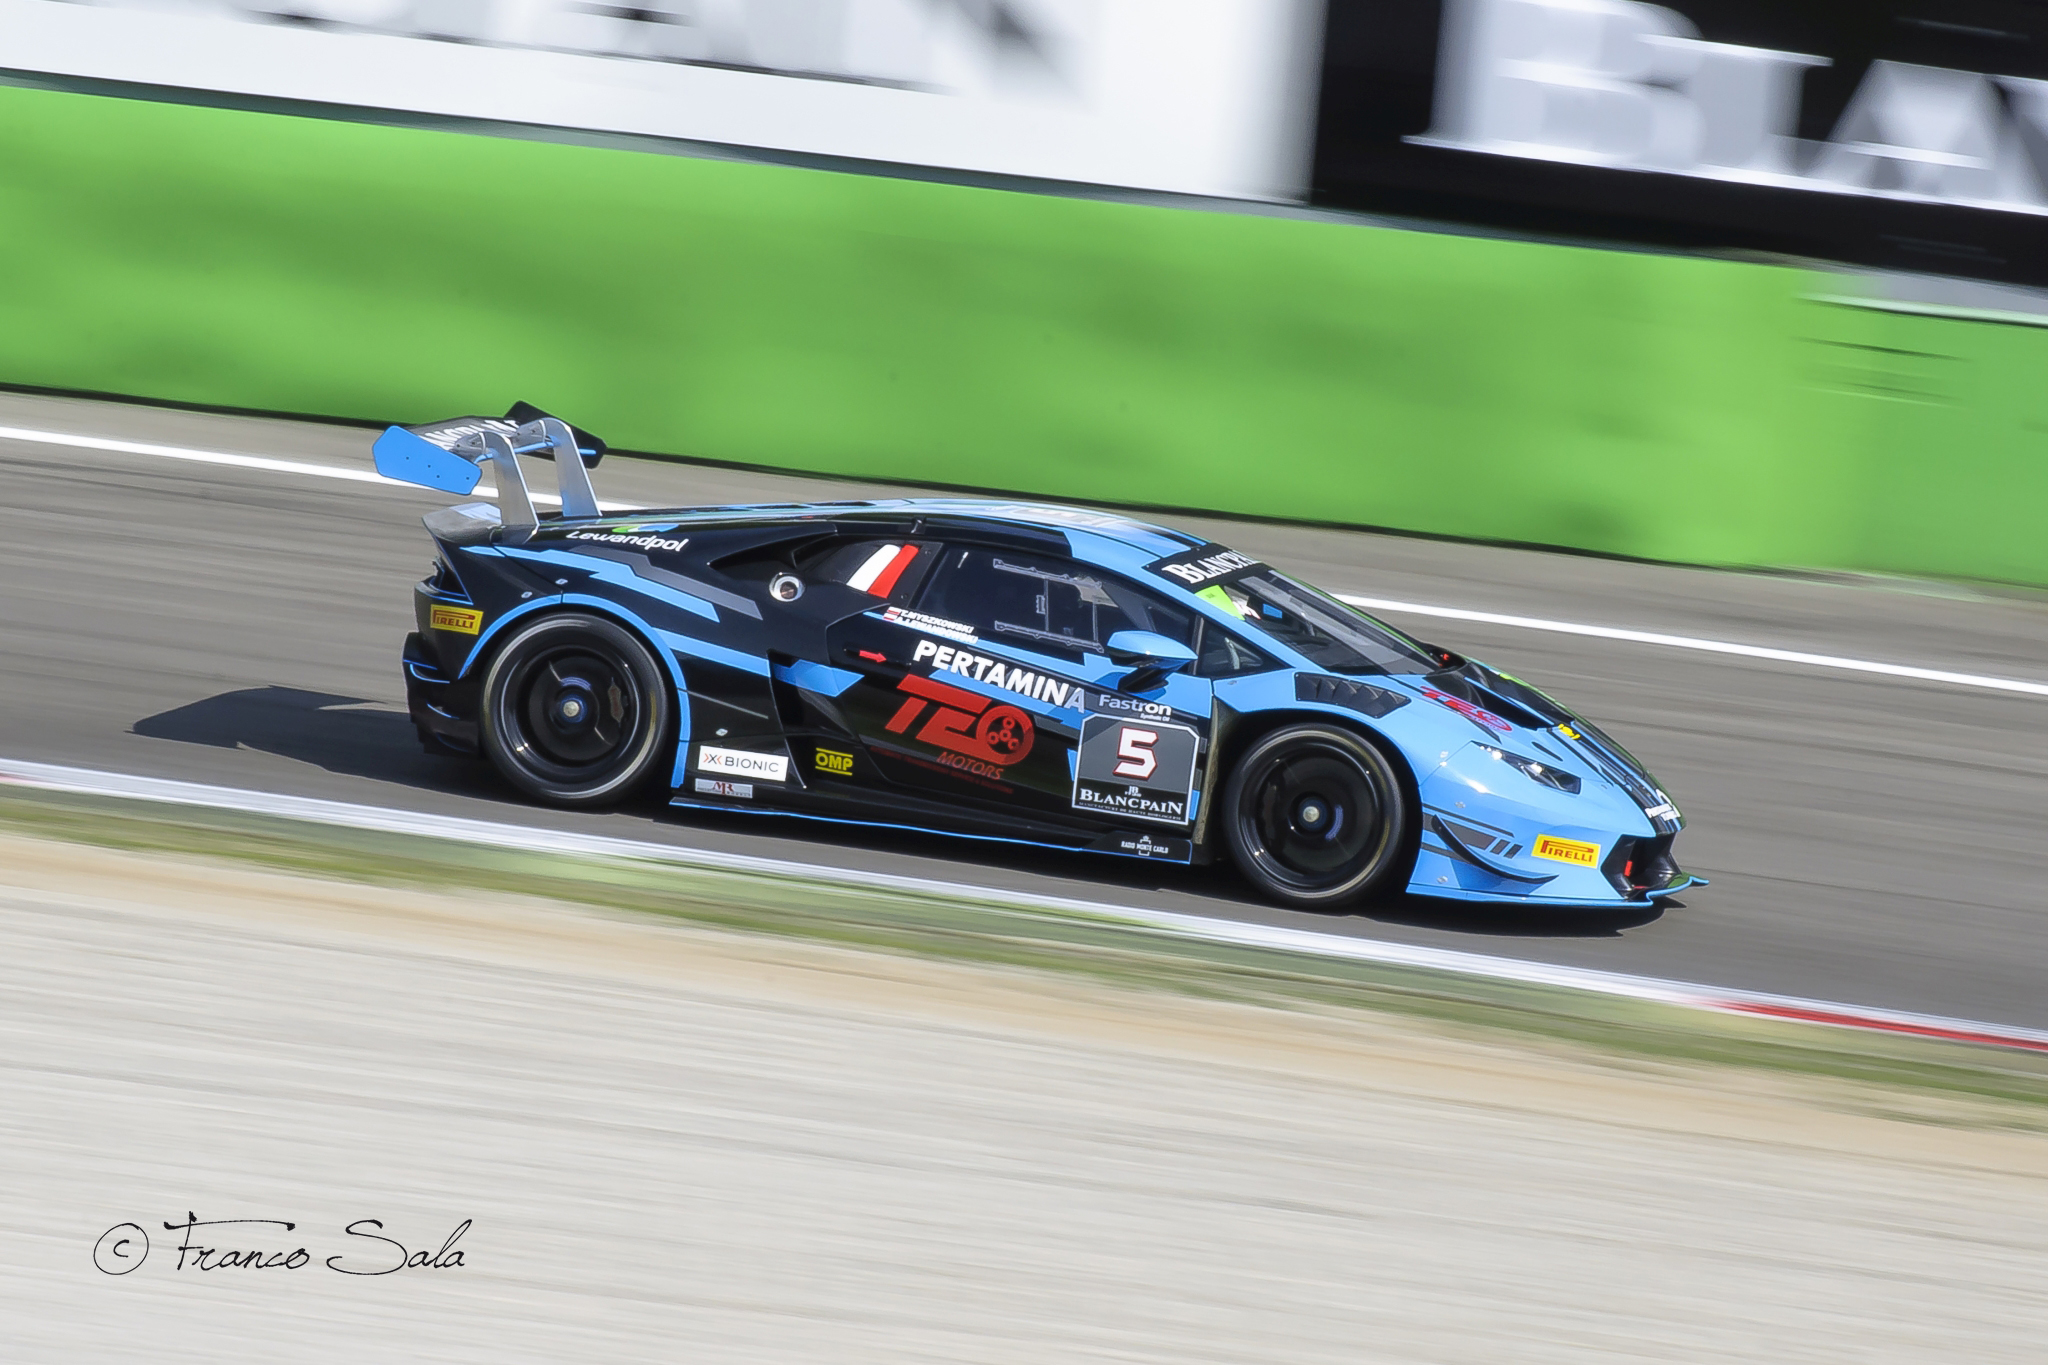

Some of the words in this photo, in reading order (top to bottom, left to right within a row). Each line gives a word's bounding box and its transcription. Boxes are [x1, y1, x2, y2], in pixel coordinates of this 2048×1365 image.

[566, 531, 689, 552] Lewandpol
[432, 609, 476, 629] PIRELLI
[912, 640, 1085, 714] PERTAMINA
[1099, 694, 1172, 716] Fastron
[725, 756, 779, 772] BIONIC
[815, 752, 853, 771] OMP
[1112, 726, 1159, 781] 5
[935, 751, 1005, 780] MOTORS
[1079, 788, 1183, 815] BLANCPAIN
[1540, 840, 1594, 862] PIRELLI
